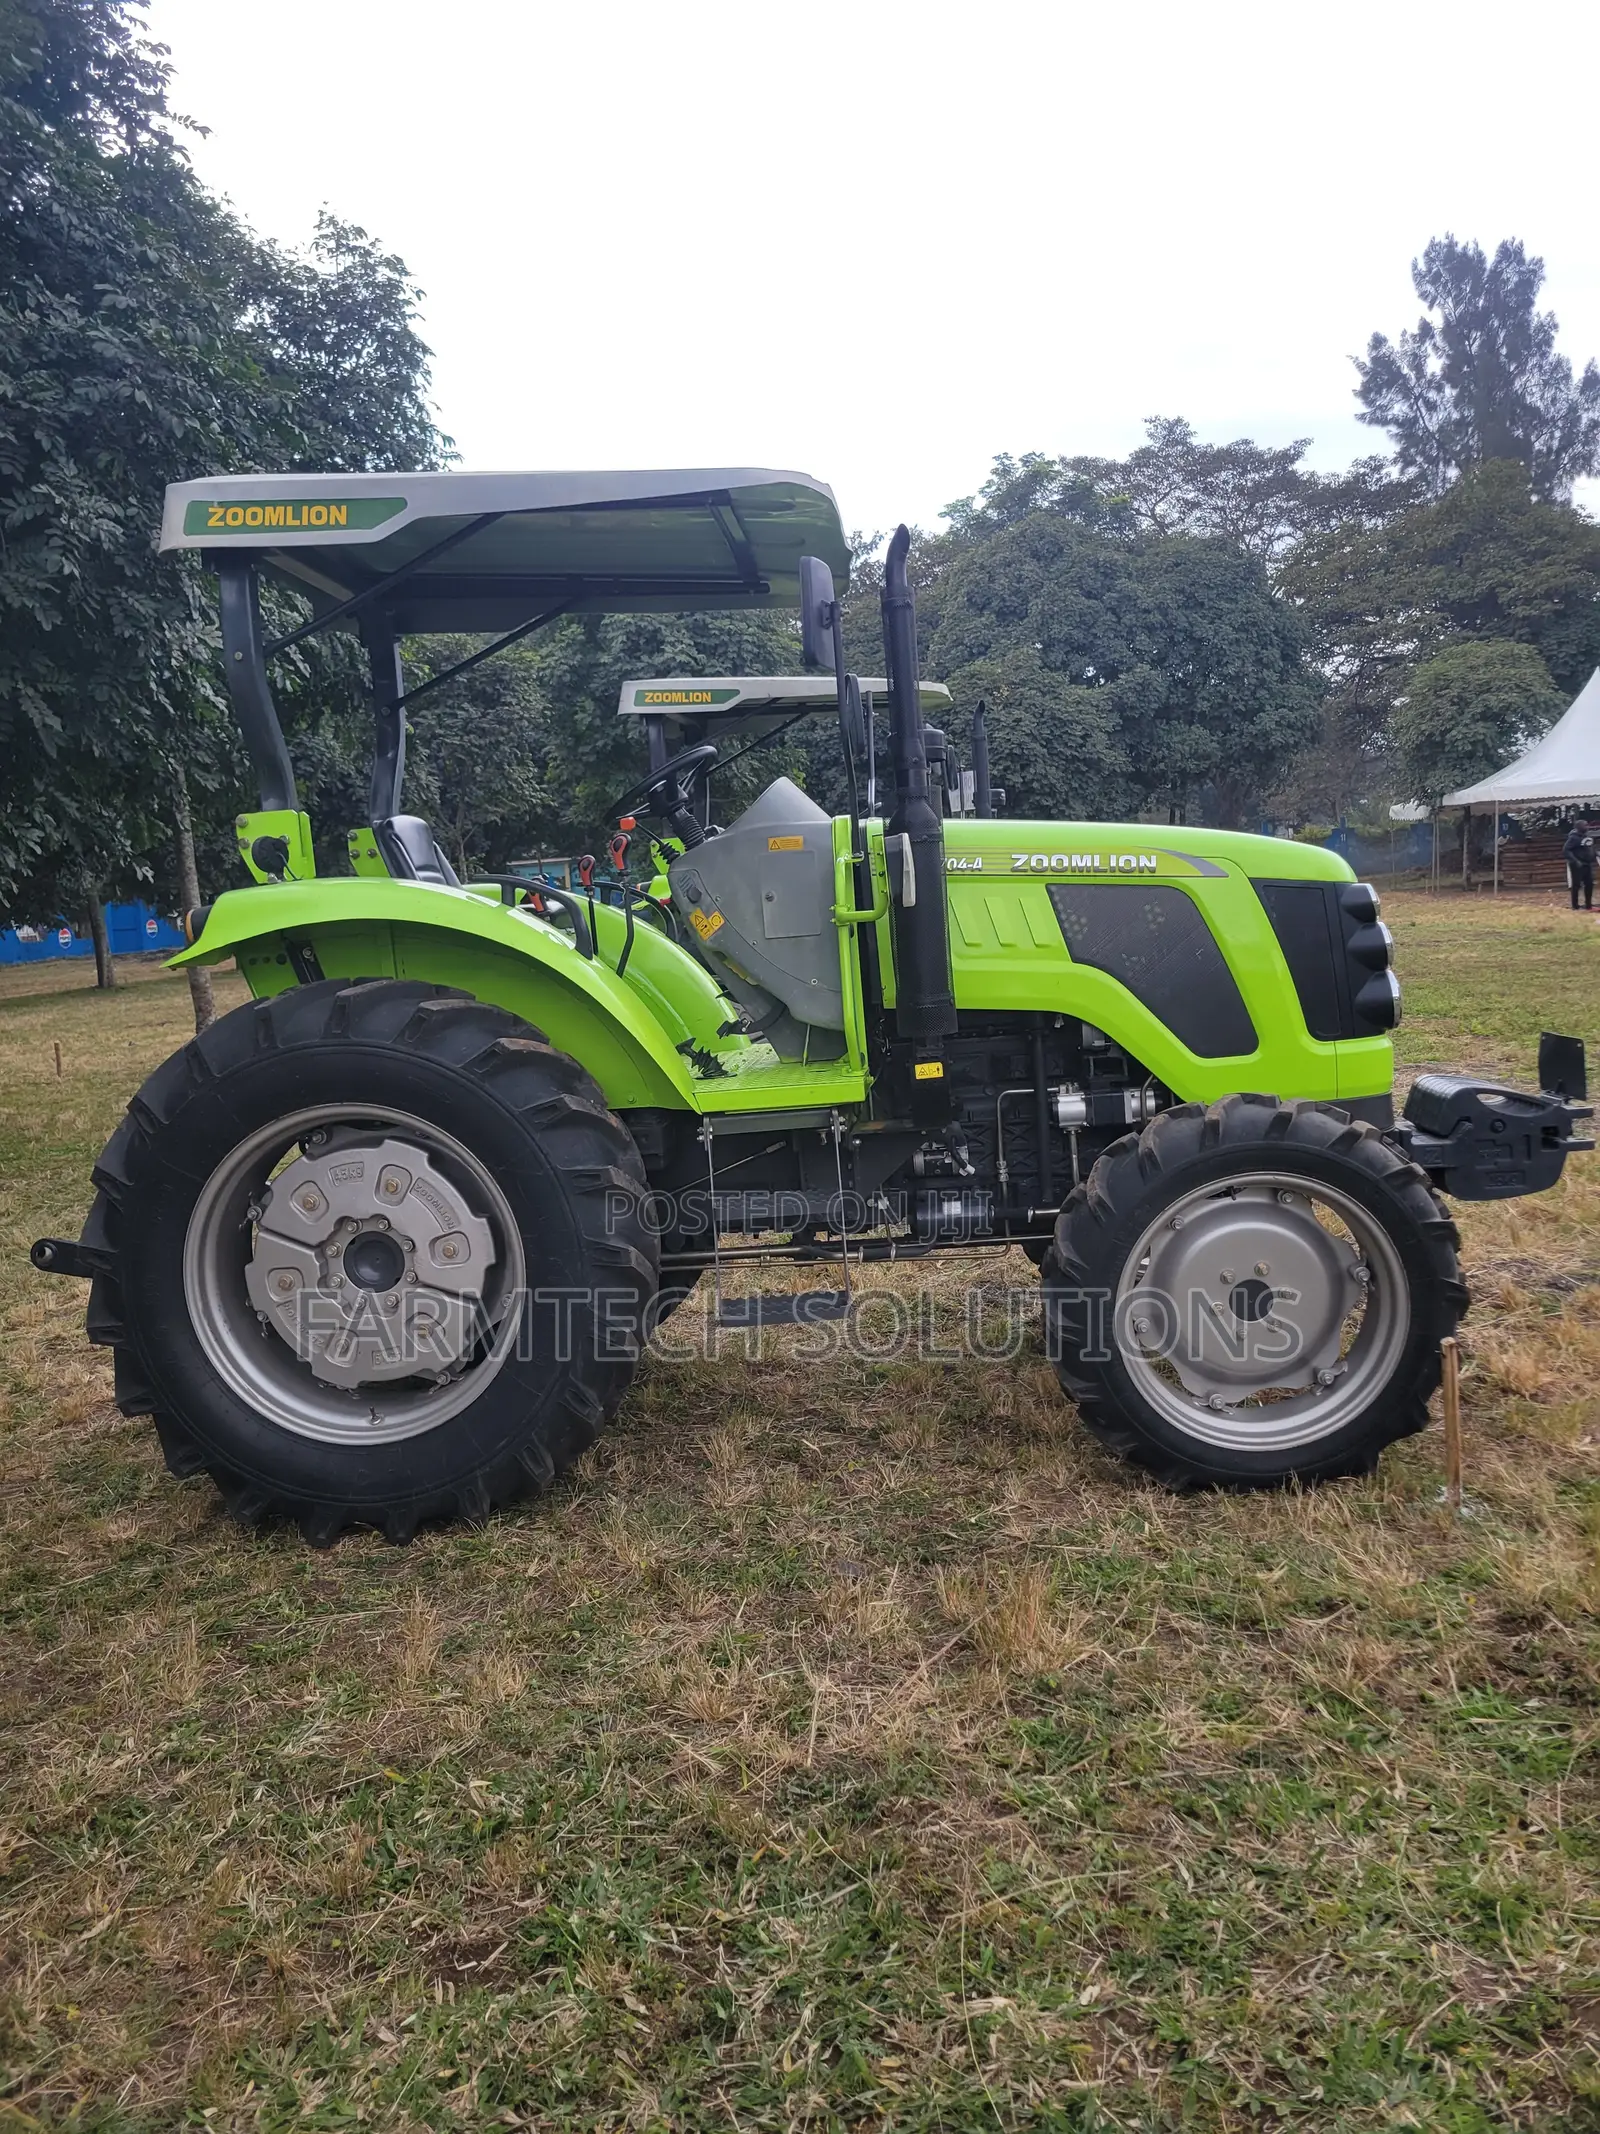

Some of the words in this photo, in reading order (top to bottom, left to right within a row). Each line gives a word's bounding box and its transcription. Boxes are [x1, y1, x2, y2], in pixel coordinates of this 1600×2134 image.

[207, 504, 347, 527] ZOOMLION
[644, 692, 711, 703] ZOOMLION
[1010, 854, 1157, 873] ZOOMLION
[414, 1183, 456, 1230] ZOOMLION
